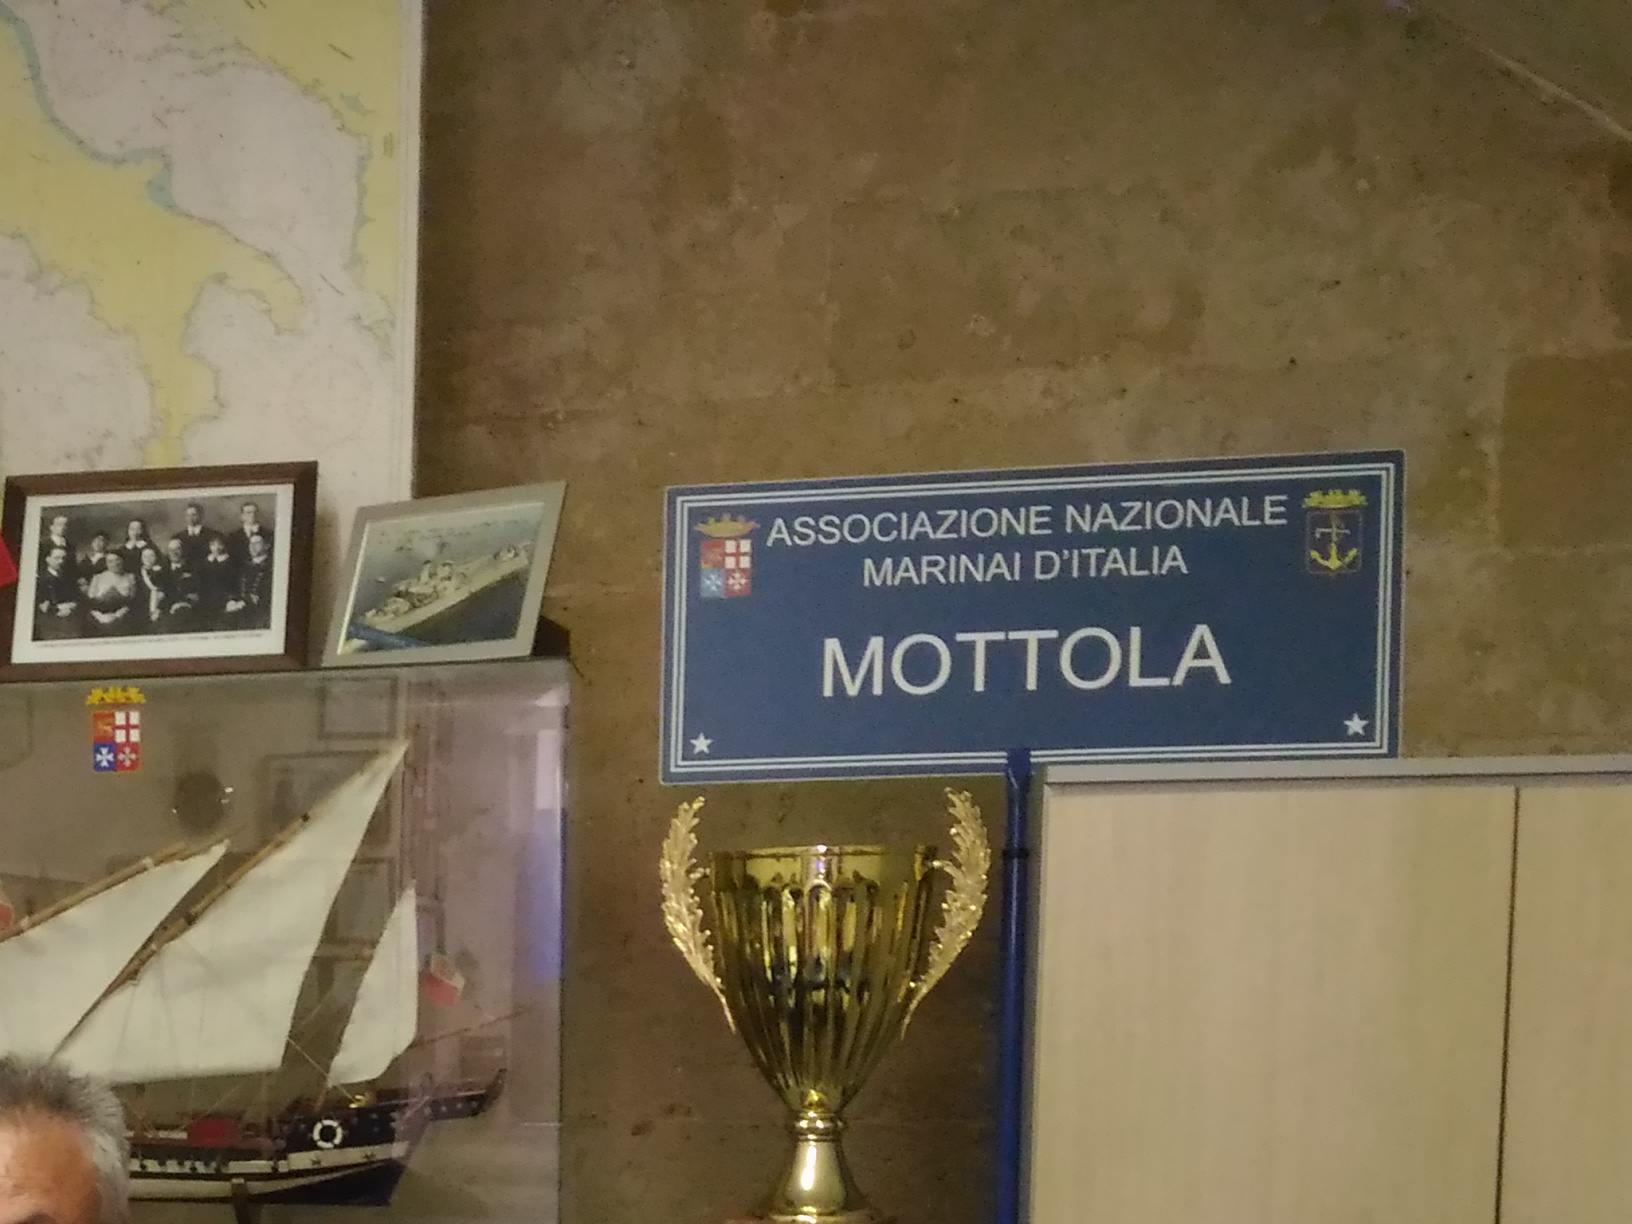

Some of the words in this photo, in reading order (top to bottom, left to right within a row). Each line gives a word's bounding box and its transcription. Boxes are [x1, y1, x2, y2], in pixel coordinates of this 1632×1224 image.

[767, 504, 1053, 547] ASSOCIAZIONE
[1065, 496, 1289, 534] NAZIONALE
[862, 550, 1022, 588] MARINAI
[1034, 545, 1189, 580] D'ITALIA
[822, 623, 1232, 698] MOTTOLA
